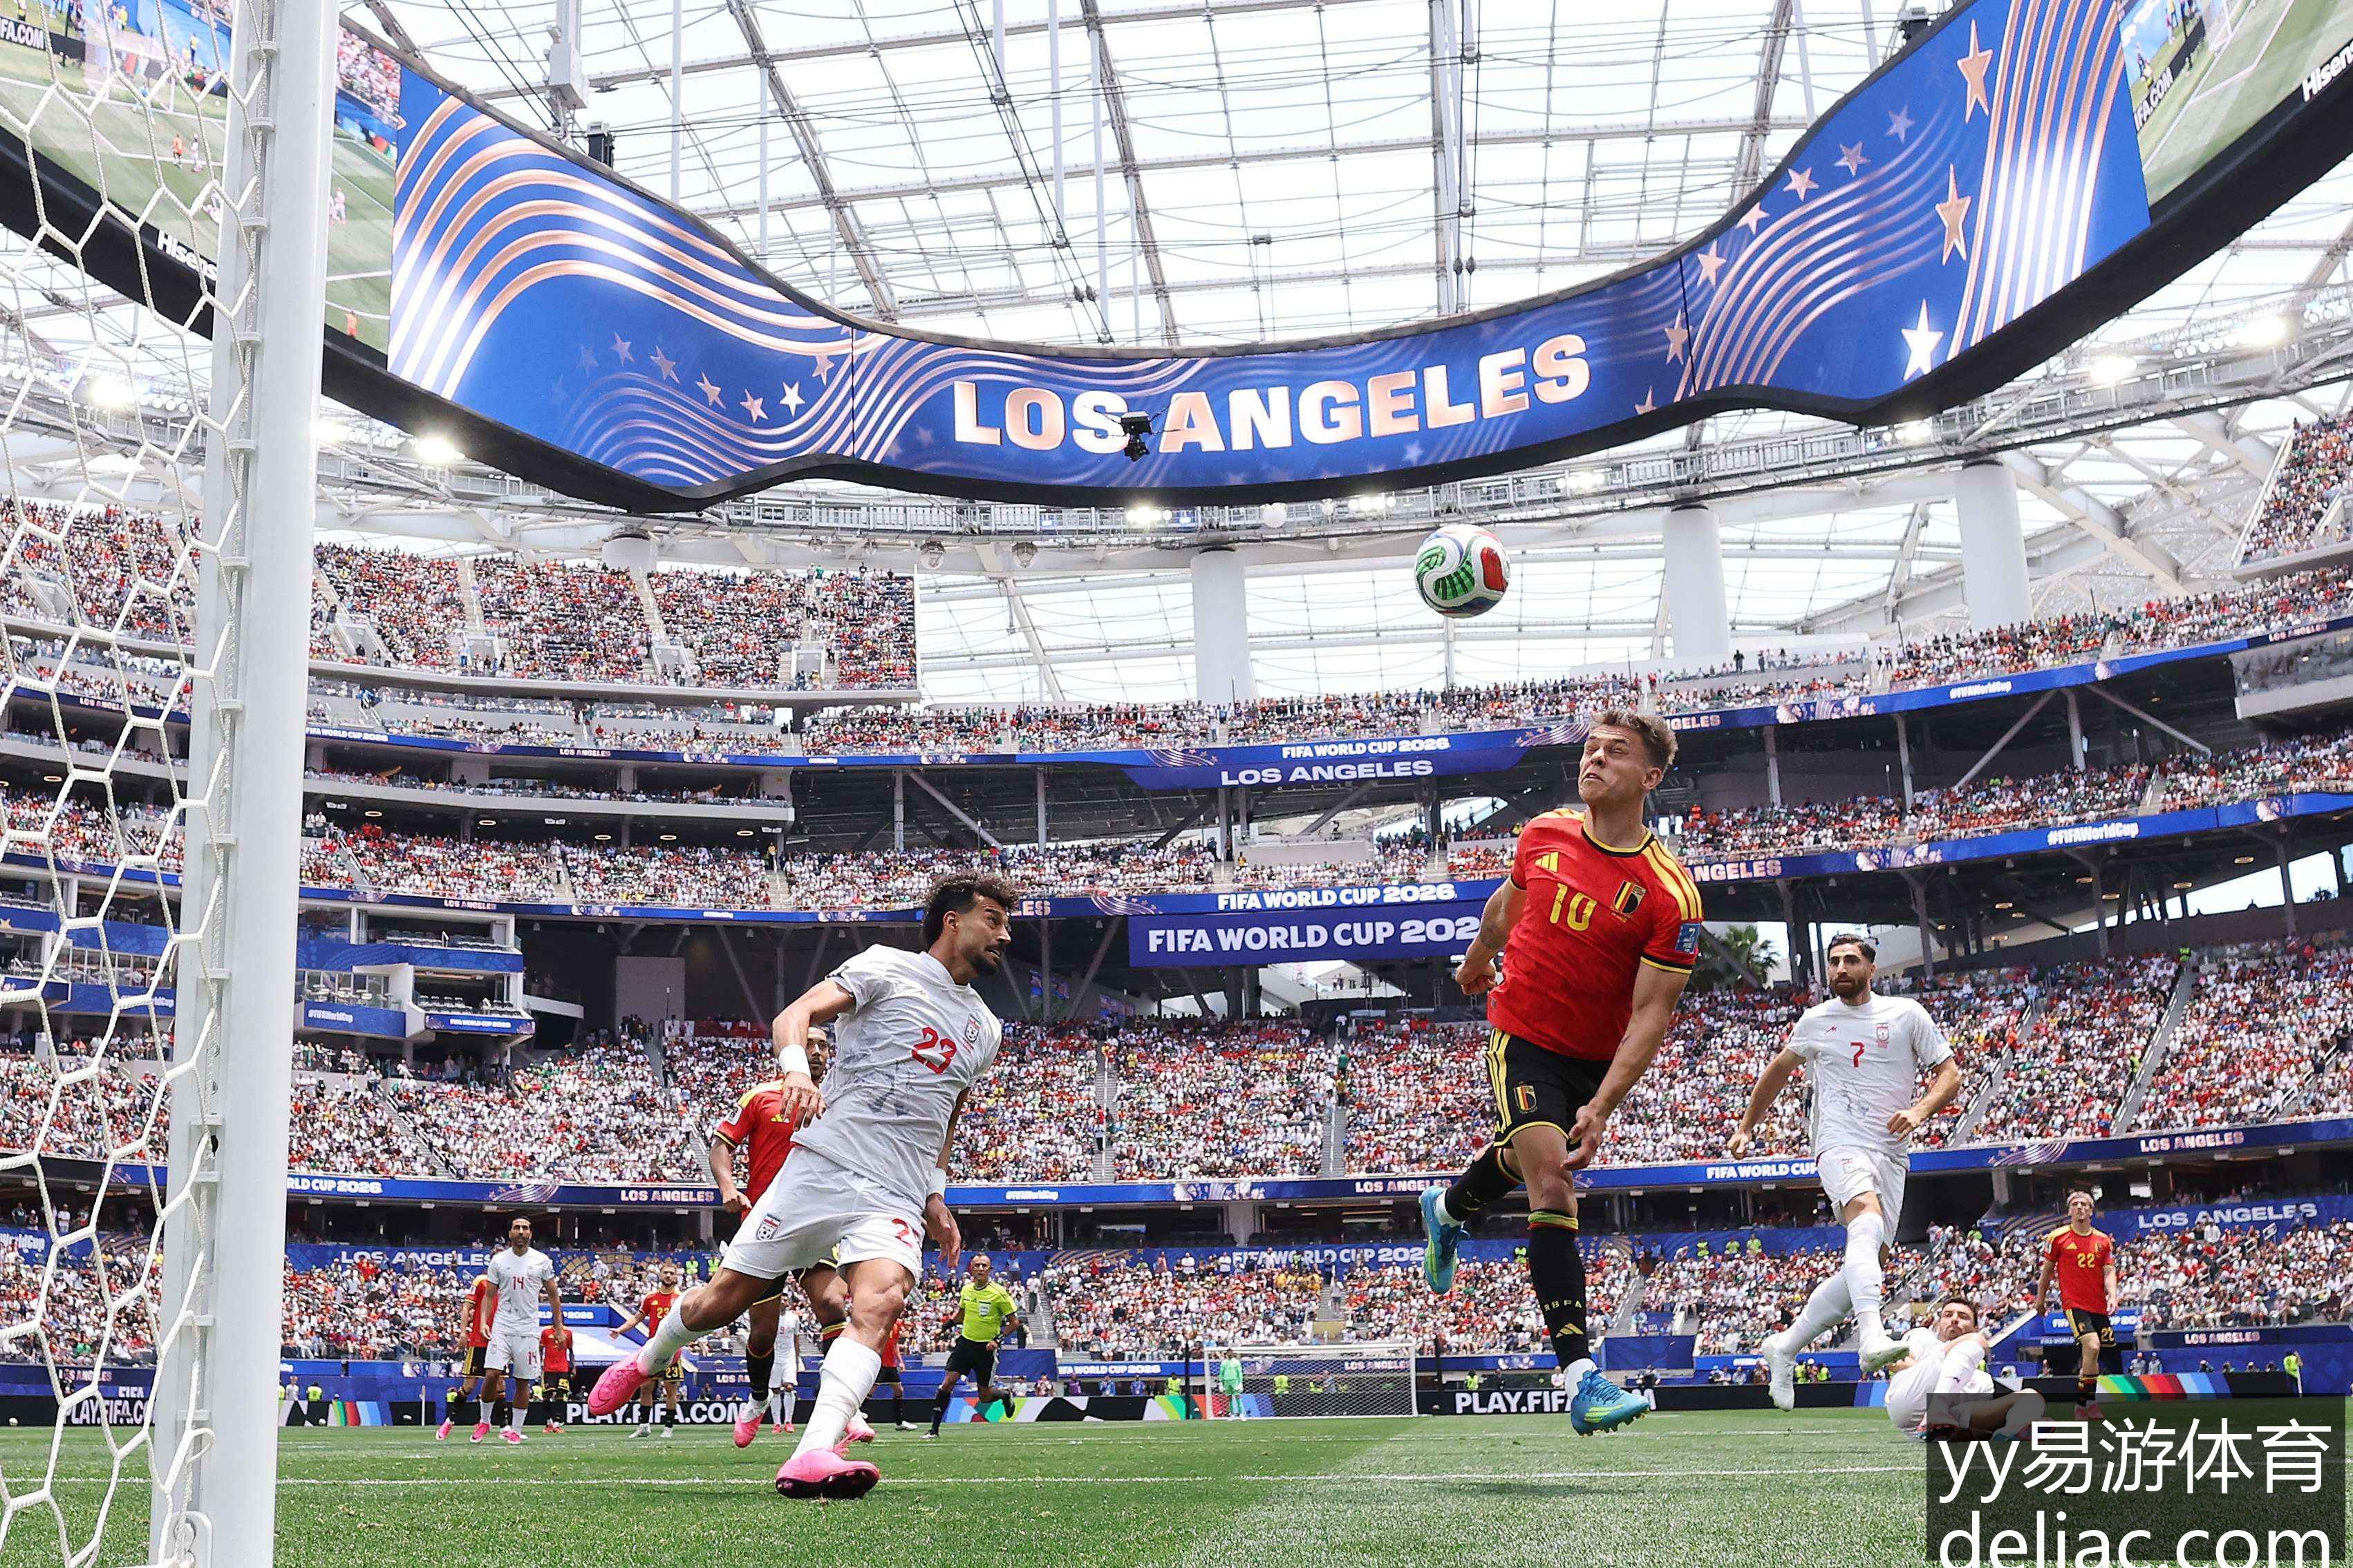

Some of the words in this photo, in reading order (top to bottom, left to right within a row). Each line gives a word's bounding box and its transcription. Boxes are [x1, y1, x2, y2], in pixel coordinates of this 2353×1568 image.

[157, 229, 218, 281] Hisens
[953, 380, 1129, 453] LOS
[1158, 334, 1591, 453] ANGELES
[1282, 746, 1313, 759] FIFA
[1313, 742, 1367, 758] WORLD
[1367, 741, 1398, 755] CUP
[1398, 737, 1450, 753] 2026
[1221, 767, 1282, 786] LOS
[1289, 759, 1434, 783] ANGELES
[1217, 893, 1260, 911] FIFA
[1260, 889, 1337, 909] WORLD
[1339, 887, 1380, 905] CUP
[1383, 882, 1457, 903] 2026
[1548, 882, 1598, 933] 10
[1147, 927, 1213, 953] FIFA
[1217, 923, 1329, 951] WORLD
[1333, 920, 1395, 947] CUP
[1399, 915, 1481, 943] 202
[912, 1026, 957, 1075] 23
[1850, 1042, 1865, 1068] 7
[1706, 1166, 1737, 1179] FIFA
[1737, 1163, 1790, 1178] WORLD
[311, 1179, 337, 1191] CUP
[1355, 1181, 1384, 1193] LOS
[621, 1190, 648, 1201] LOS
[651, 1190, 715, 1202] ANGELES
[2138, 1213, 2189, 1228] LOS
[2195, 1203, 2318, 1225] ANGELES
[341, 1251, 384, 1264] LOS
[1378, 1247, 1425, 1262] 202
[2077, 1252, 2095, 1268] 22
[513, 1276, 524, 1290] 14
[528, 1351, 537, 1365] 14
[665, 1367, 679, 1379] 23
